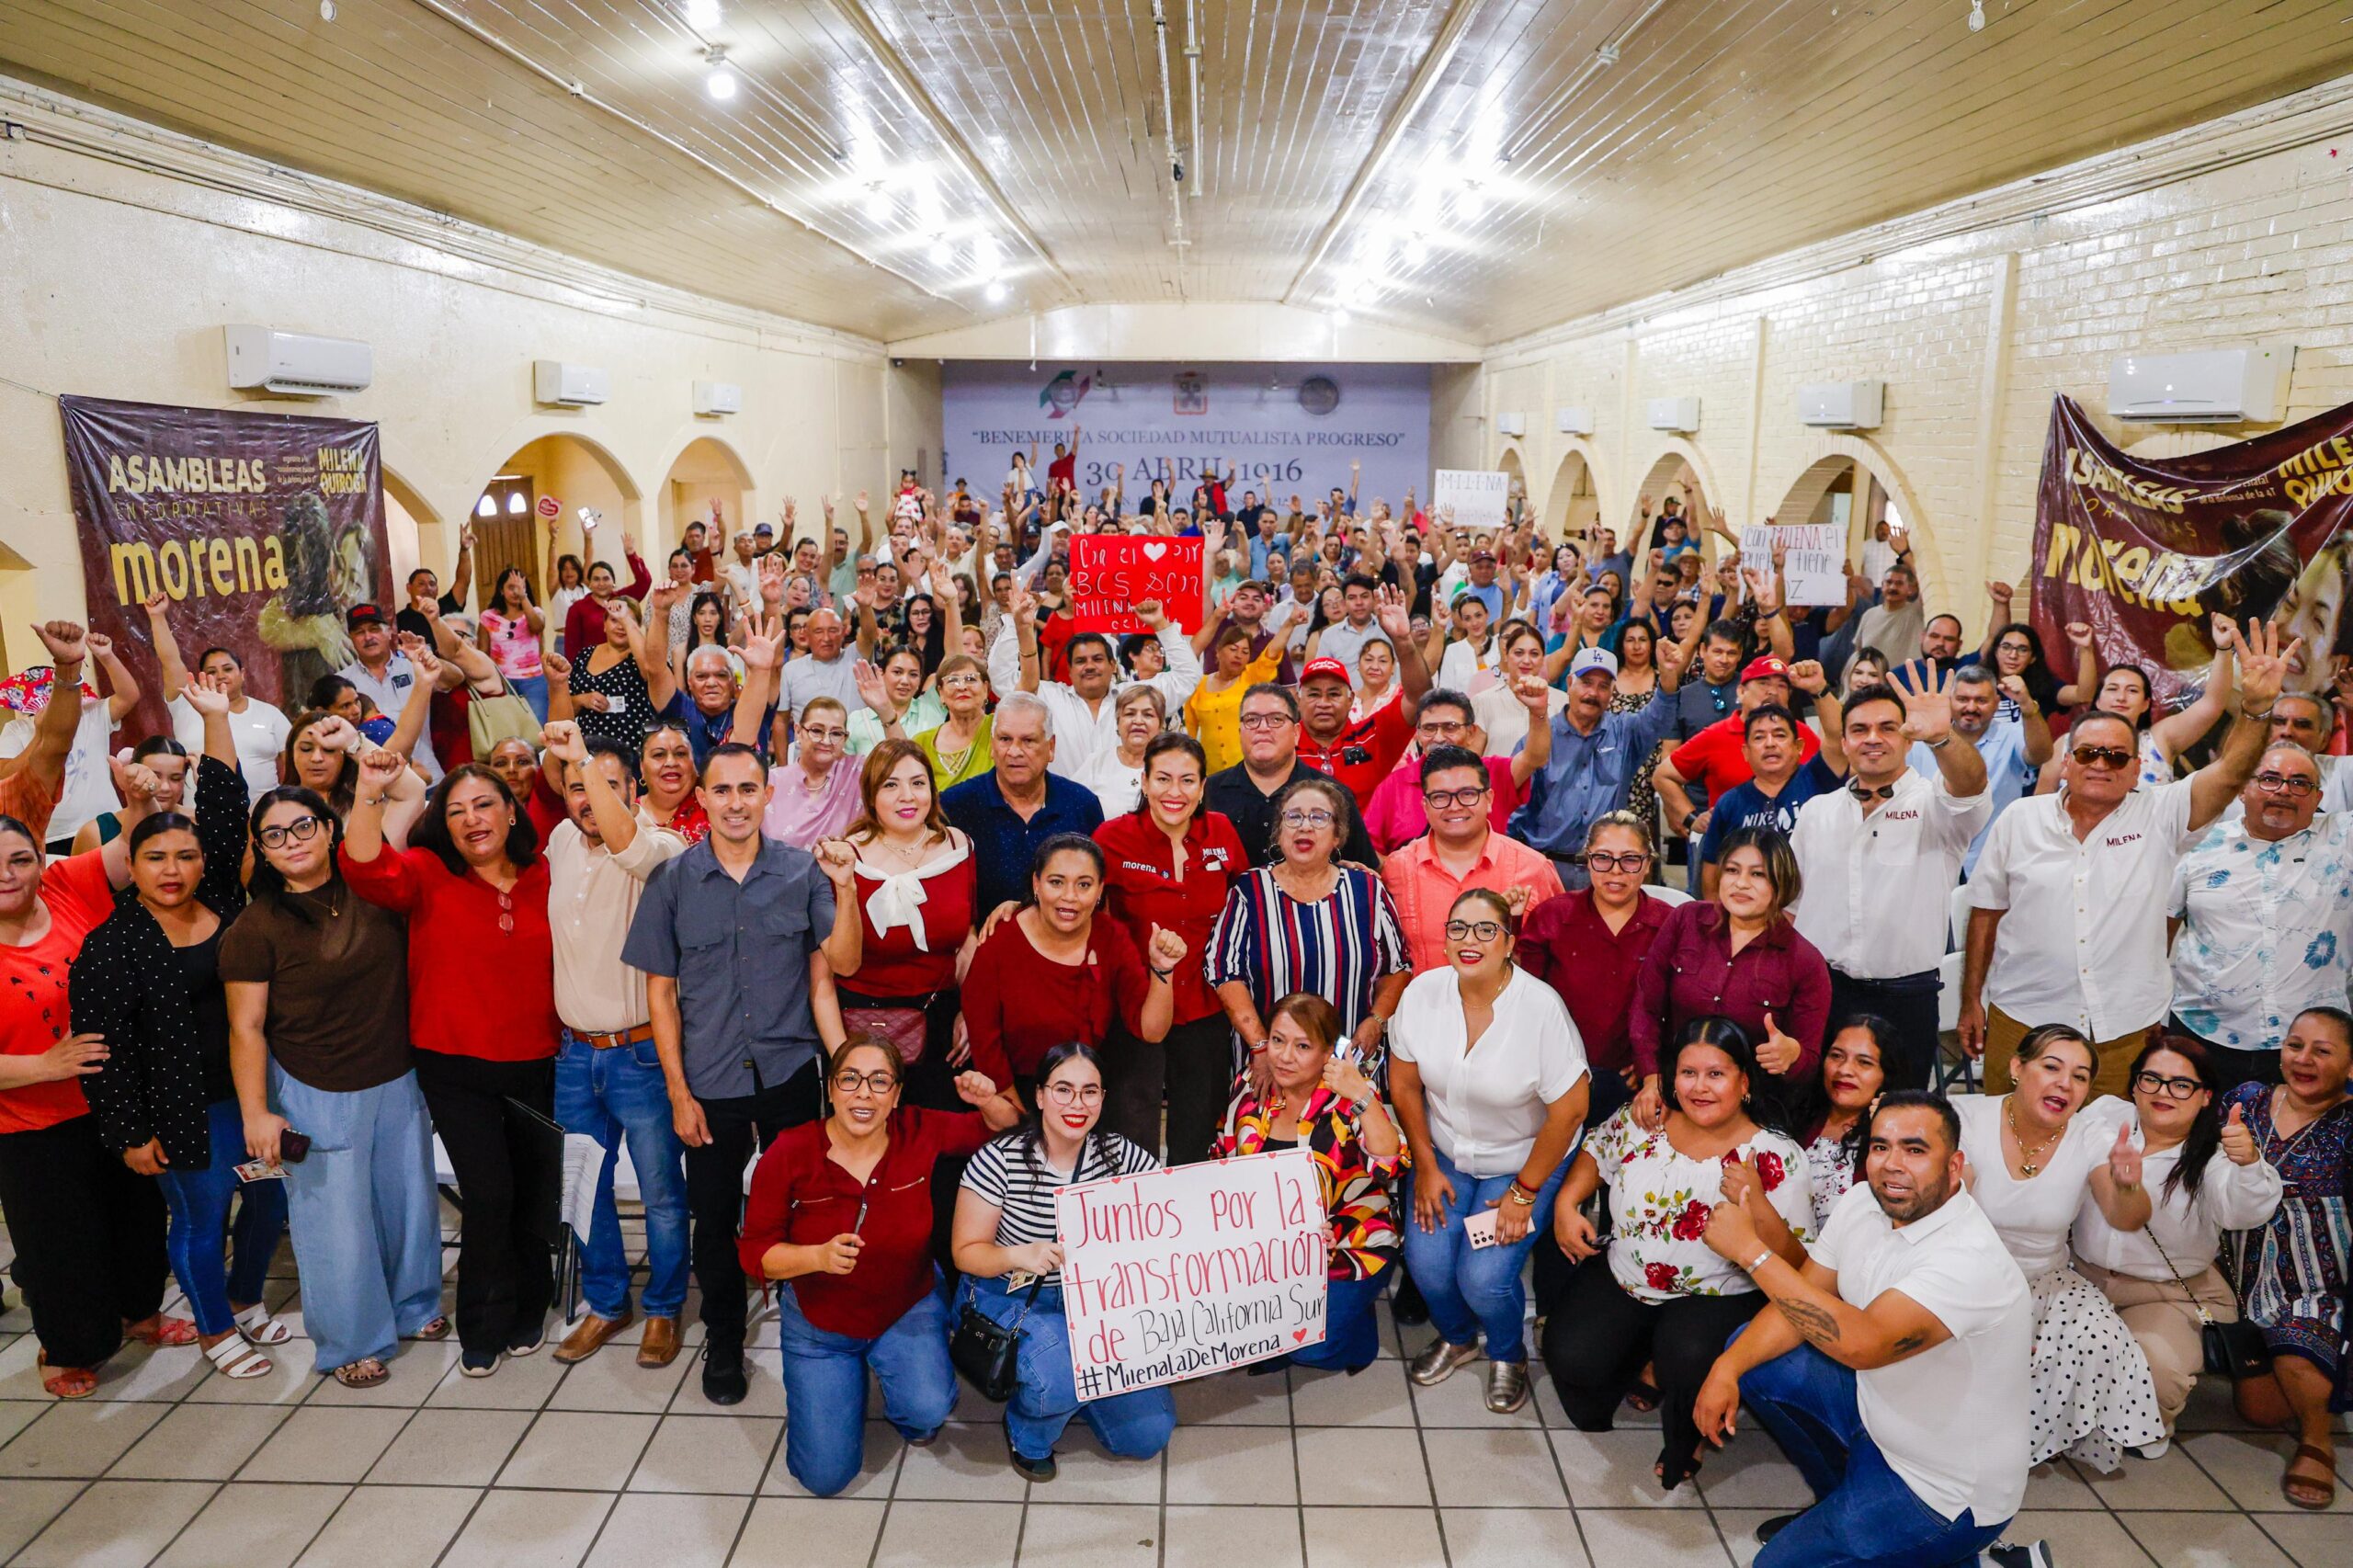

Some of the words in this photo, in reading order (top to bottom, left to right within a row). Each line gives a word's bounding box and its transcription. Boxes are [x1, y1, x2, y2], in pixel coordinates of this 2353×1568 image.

[1097, 430, 1185, 445] SOCIEDAD
[1189, 431, 1302, 446] MUTUALISTA
[317, 448, 367, 471] MILENA
[2278, 436, 2353, 478] MILE
[108, 454, 267, 494] ASAMBLEAS
[319, 472, 368, 498] QUIROGA
[1240, 458, 1302, 488] 1916
[114, 500, 268, 520] INFORMATIVAS
[1772, 526, 1823, 550] MILENA
[1825, 527, 1839, 549] el
[109, 533, 290, 607] morena
[1795, 551, 1832, 574] tiene
[1076, 571, 1131, 597] BCS
[1593, 650, 1603, 662] LA
[1885, 810, 1918, 819] MILENA
[1202, 846, 1227, 857] MILENA
[2106, 833, 2143, 846] MILENA
[1122, 860, 1156, 873] morena
[1070, 1181, 1182, 1249] Juntos
[1210, 1188, 1256, 1232] por
[1274, 1171, 1306, 1231] la
[1064, 1230, 1324, 1317] transformación
[1088, 1319, 1128, 1365] de
[1131, 1308, 1186, 1356] Baja
[1191, 1293, 1283, 1346] California
[1289, 1282, 1324, 1326] Sur
